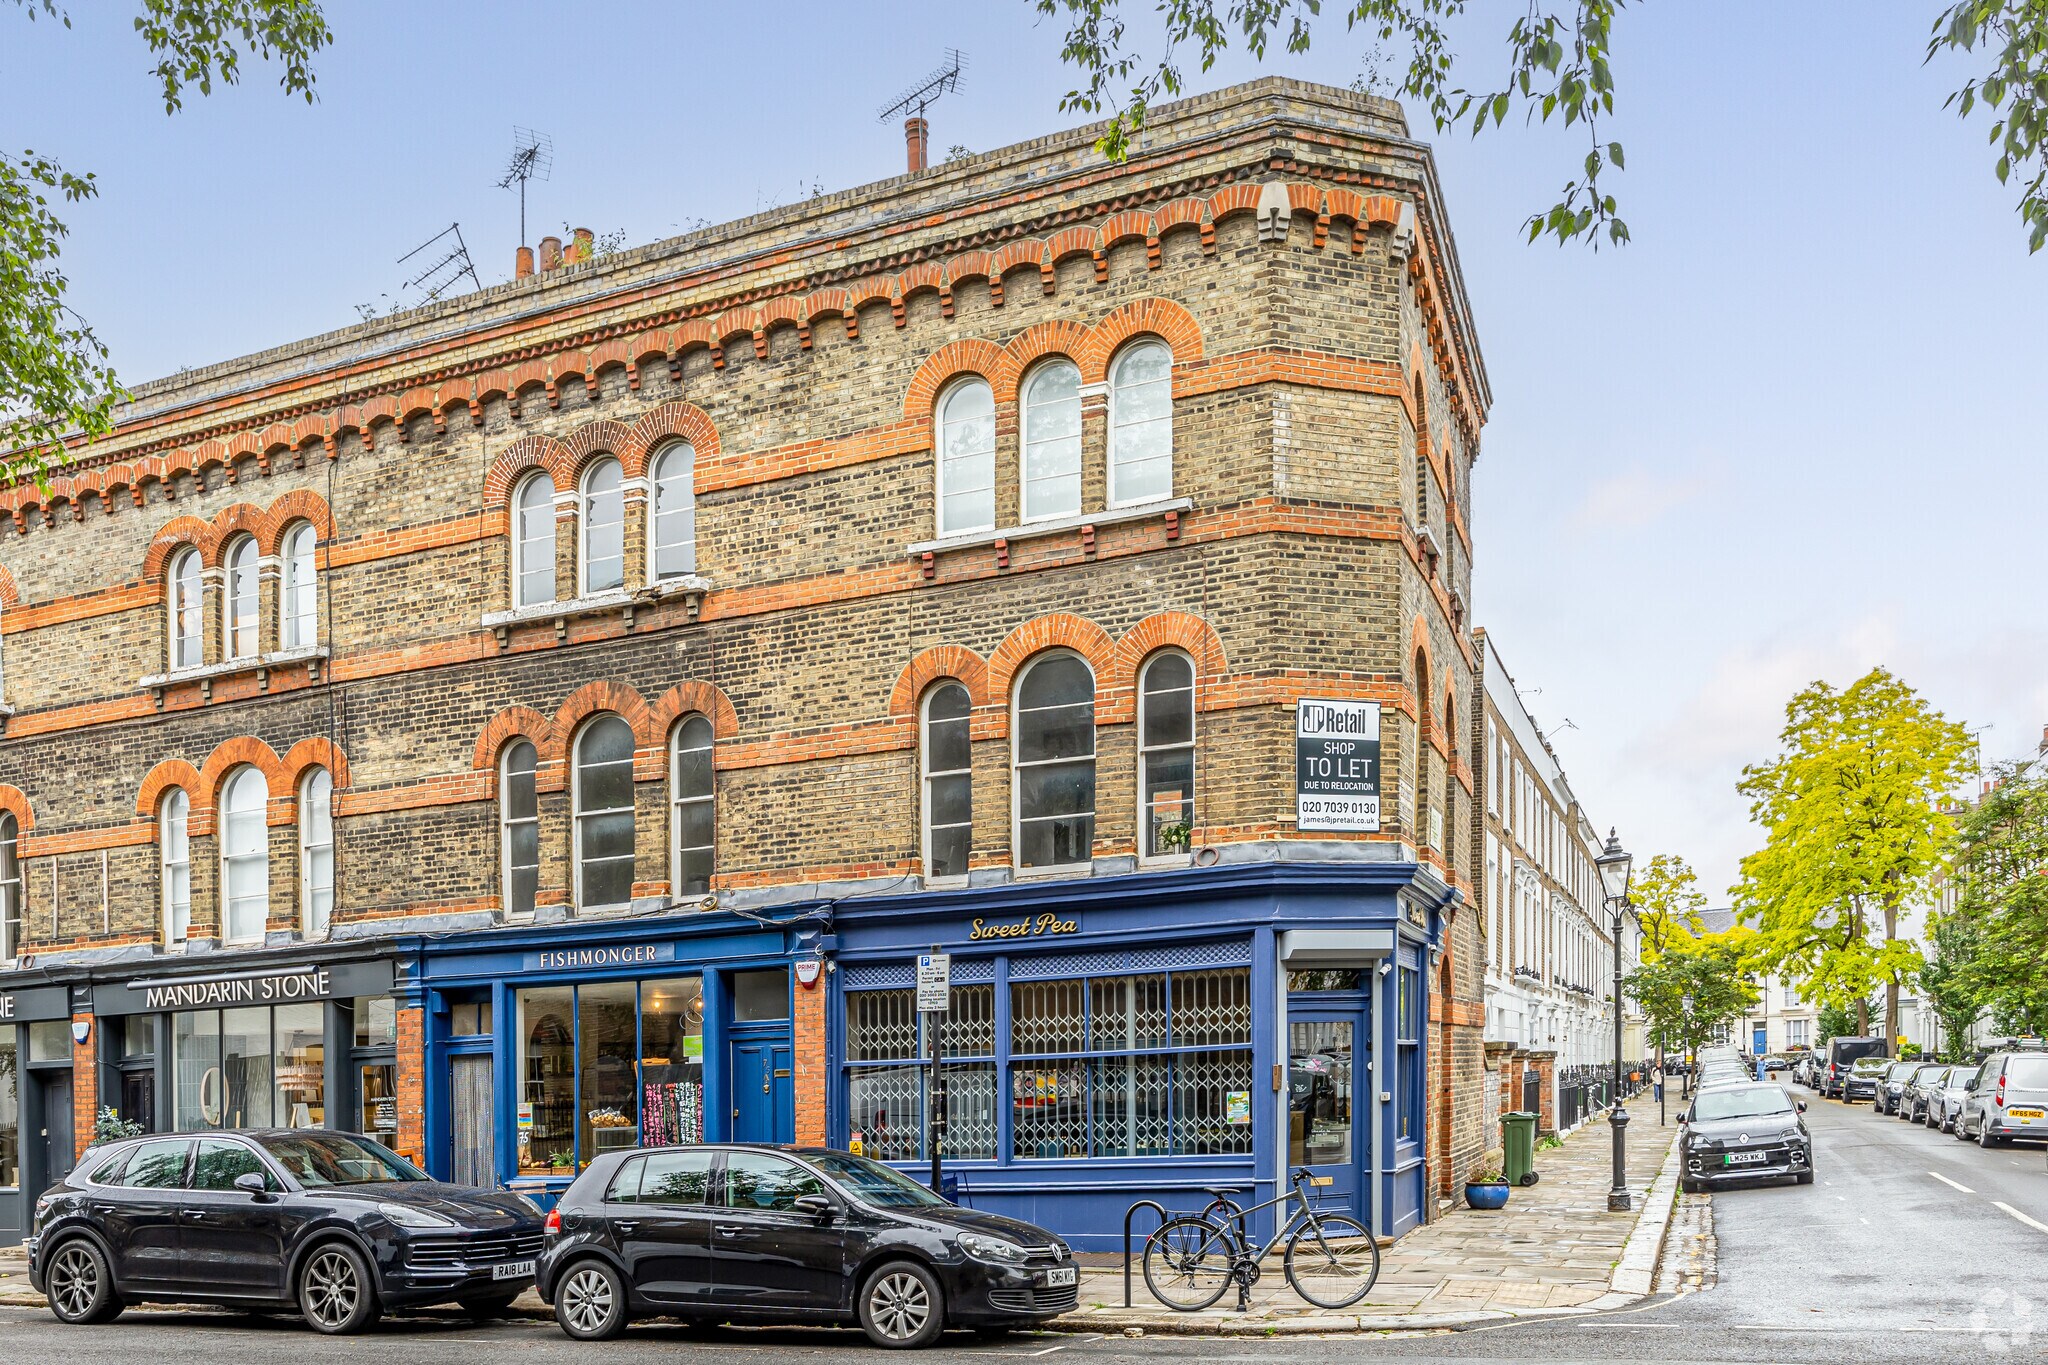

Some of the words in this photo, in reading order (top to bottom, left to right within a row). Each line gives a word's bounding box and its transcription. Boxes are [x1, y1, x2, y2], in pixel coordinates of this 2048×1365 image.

[1326, 707, 1366, 734] Retail
[1324, 741, 1356, 755] SHOP
[1306, 757, 1331, 777] TO
[1338, 758, 1372, 778] LET
[1304, 781, 1319, 790] DUE
[1320, 781, 1330, 790] TO
[1331, 782, 1374, 791] RELOCATION
[1302, 801, 1321, 812] 020
[1324, 802, 1349, 813] 7039
[1351, 802, 1376, 814] 0130
[1303, 816, 1375, 825] james@jpretail.co.uk
[969, 916, 1031, 940] Sweet
[1033, 912, 1077, 935] Pea
[540, 945, 657, 968] FISHMONGER
[146, 979, 253, 1008] MANDARIN
[262, 972, 330, 999] STONE
[518, 1131, 530, 1144] 75
[1729, 1154, 1749, 1162] LM25
[498, 1264, 517, 1276] RA18
[517, 1262, 532, 1274] LAA
